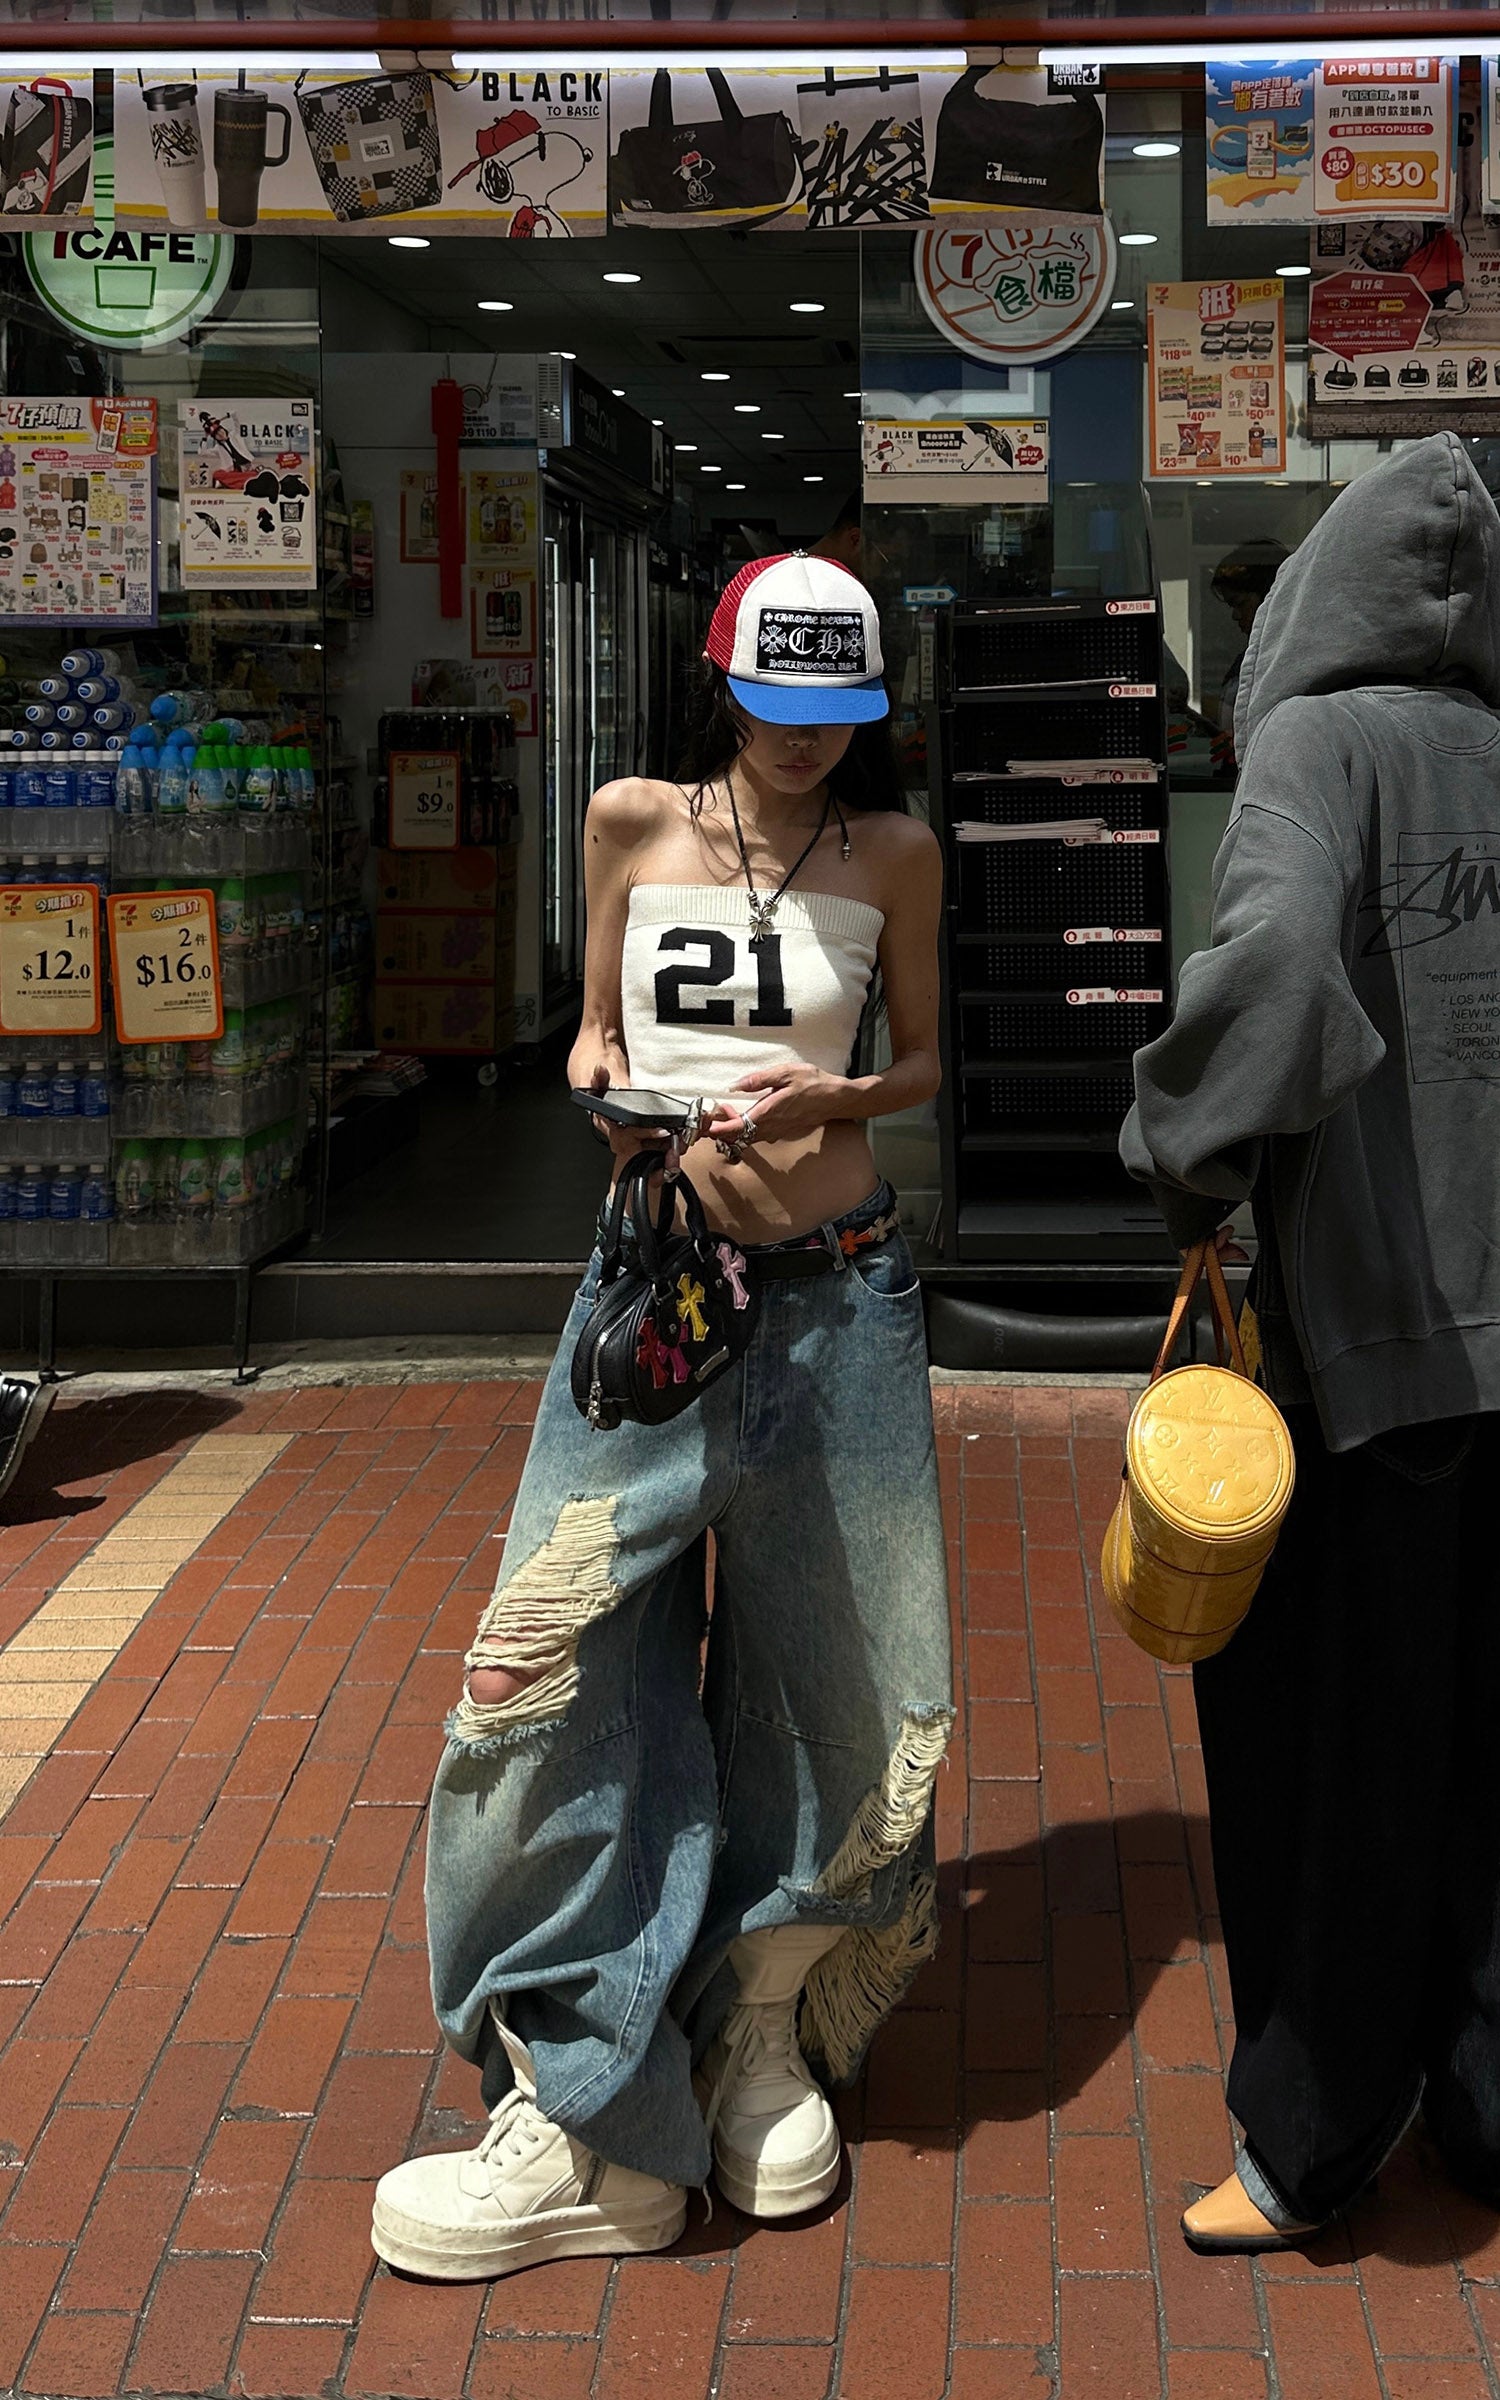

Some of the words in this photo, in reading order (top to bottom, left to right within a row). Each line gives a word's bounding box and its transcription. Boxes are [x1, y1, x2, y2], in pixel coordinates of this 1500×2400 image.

[1053, 64, 1083, 74] URBAN
[483, 73, 602, 101] BLACK
[1058, 75, 1082, 85] STYLE
[547, 106, 561, 116] TO
[567, 106, 600, 116] BASIC
[1327, 160, 1349, 173] $80
[1371, 161, 1424, 186] $30
[1028, 177, 1047, 186] STYLE
[951, 235, 983, 278] 7
[240, 425, 295, 437] BLACK
[882, 431, 913, 439] BLACK
[1120, 603, 1150, 611] 東方日報
[789, 627, 842, 659] CH
[36, 893, 85, 913] 今期推介
[151, 899, 200, 921] 今期推介
[65, 919, 73, 938] 1
[79, 926, 90, 938] 件
[178, 928, 192, 946] 2
[196, 933, 207, 945] 件
[23, 950, 90, 981] $12.0
[136, 952, 211, 988] $16.0
[654, 927, 792, 1026] 21
[1450, 995, 1474, 1005] LOS
[1452, 1009, 1480, 1019] NEW
[1453, 1023, 1494, 1033] SEOUL
